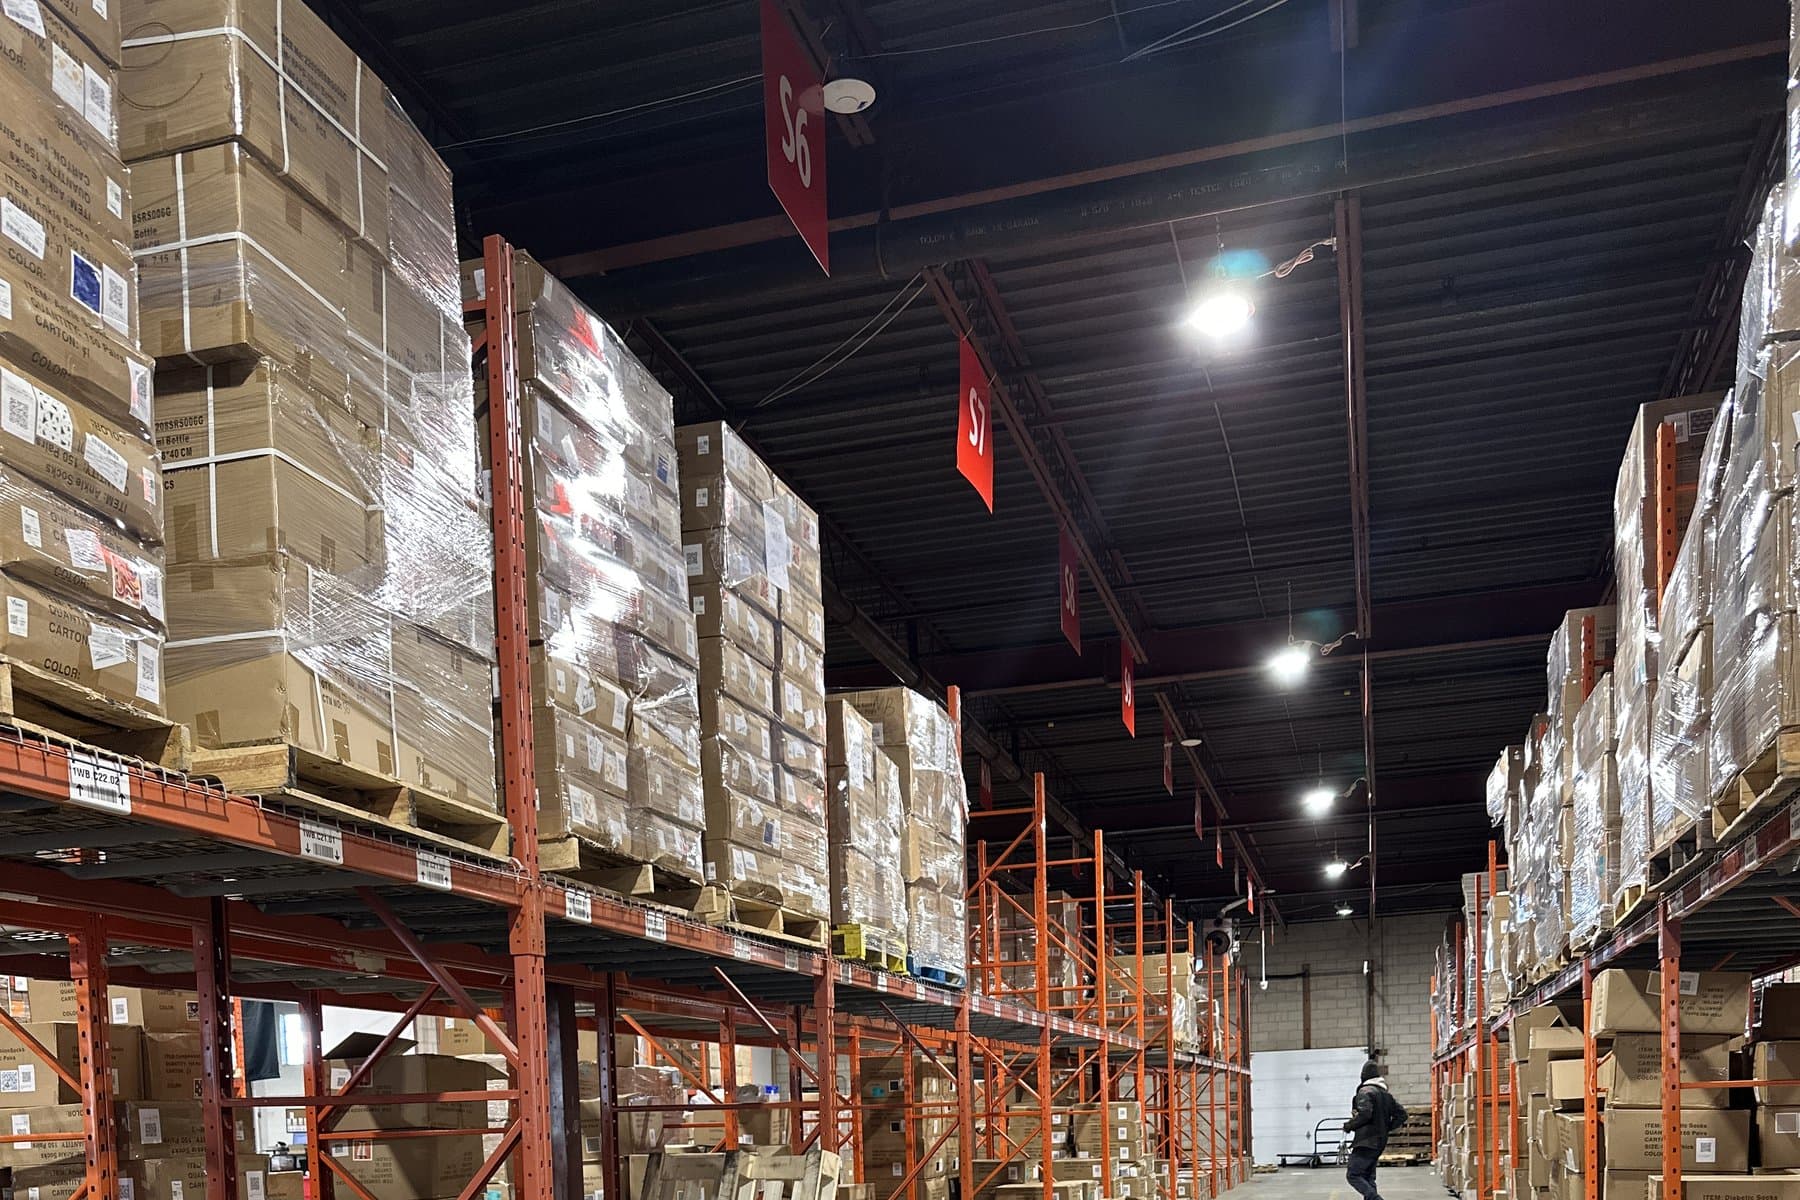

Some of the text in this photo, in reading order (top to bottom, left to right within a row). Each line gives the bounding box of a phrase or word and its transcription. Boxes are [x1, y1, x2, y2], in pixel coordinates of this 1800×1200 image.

[0, 42, 27, 71] OLOR:
[779, 74, 811, 188] S6
[9, 150, 38, 179] Socks
[24, 143, 40, 162] 150
[39, 174, 65, 200] Ankle
[44, 159, 91, 204] QUANTITY:
[8, 248, 47, 280] COLOR:
[35, 314, 79, 350] CARTON:
[31, 351, 72, 377] COLOR:
[969, 387, 985, 456] S7
[166, 435, 190, 446] Bottle
[181, 447, 193, 457] CM
[62, 452, 78, 469] 150
[45, 463, 73, 486] Socks
[164, 480, 175, 490] CS
[75, 478, 101, 499] Ankle
[103, 493, 128, 514] ITEM:
[1065, 564, 1075, 617] S8
[43, 658, 81, 680] COLOR:
[73, 767, 120, 786] 1WB.C22.02
